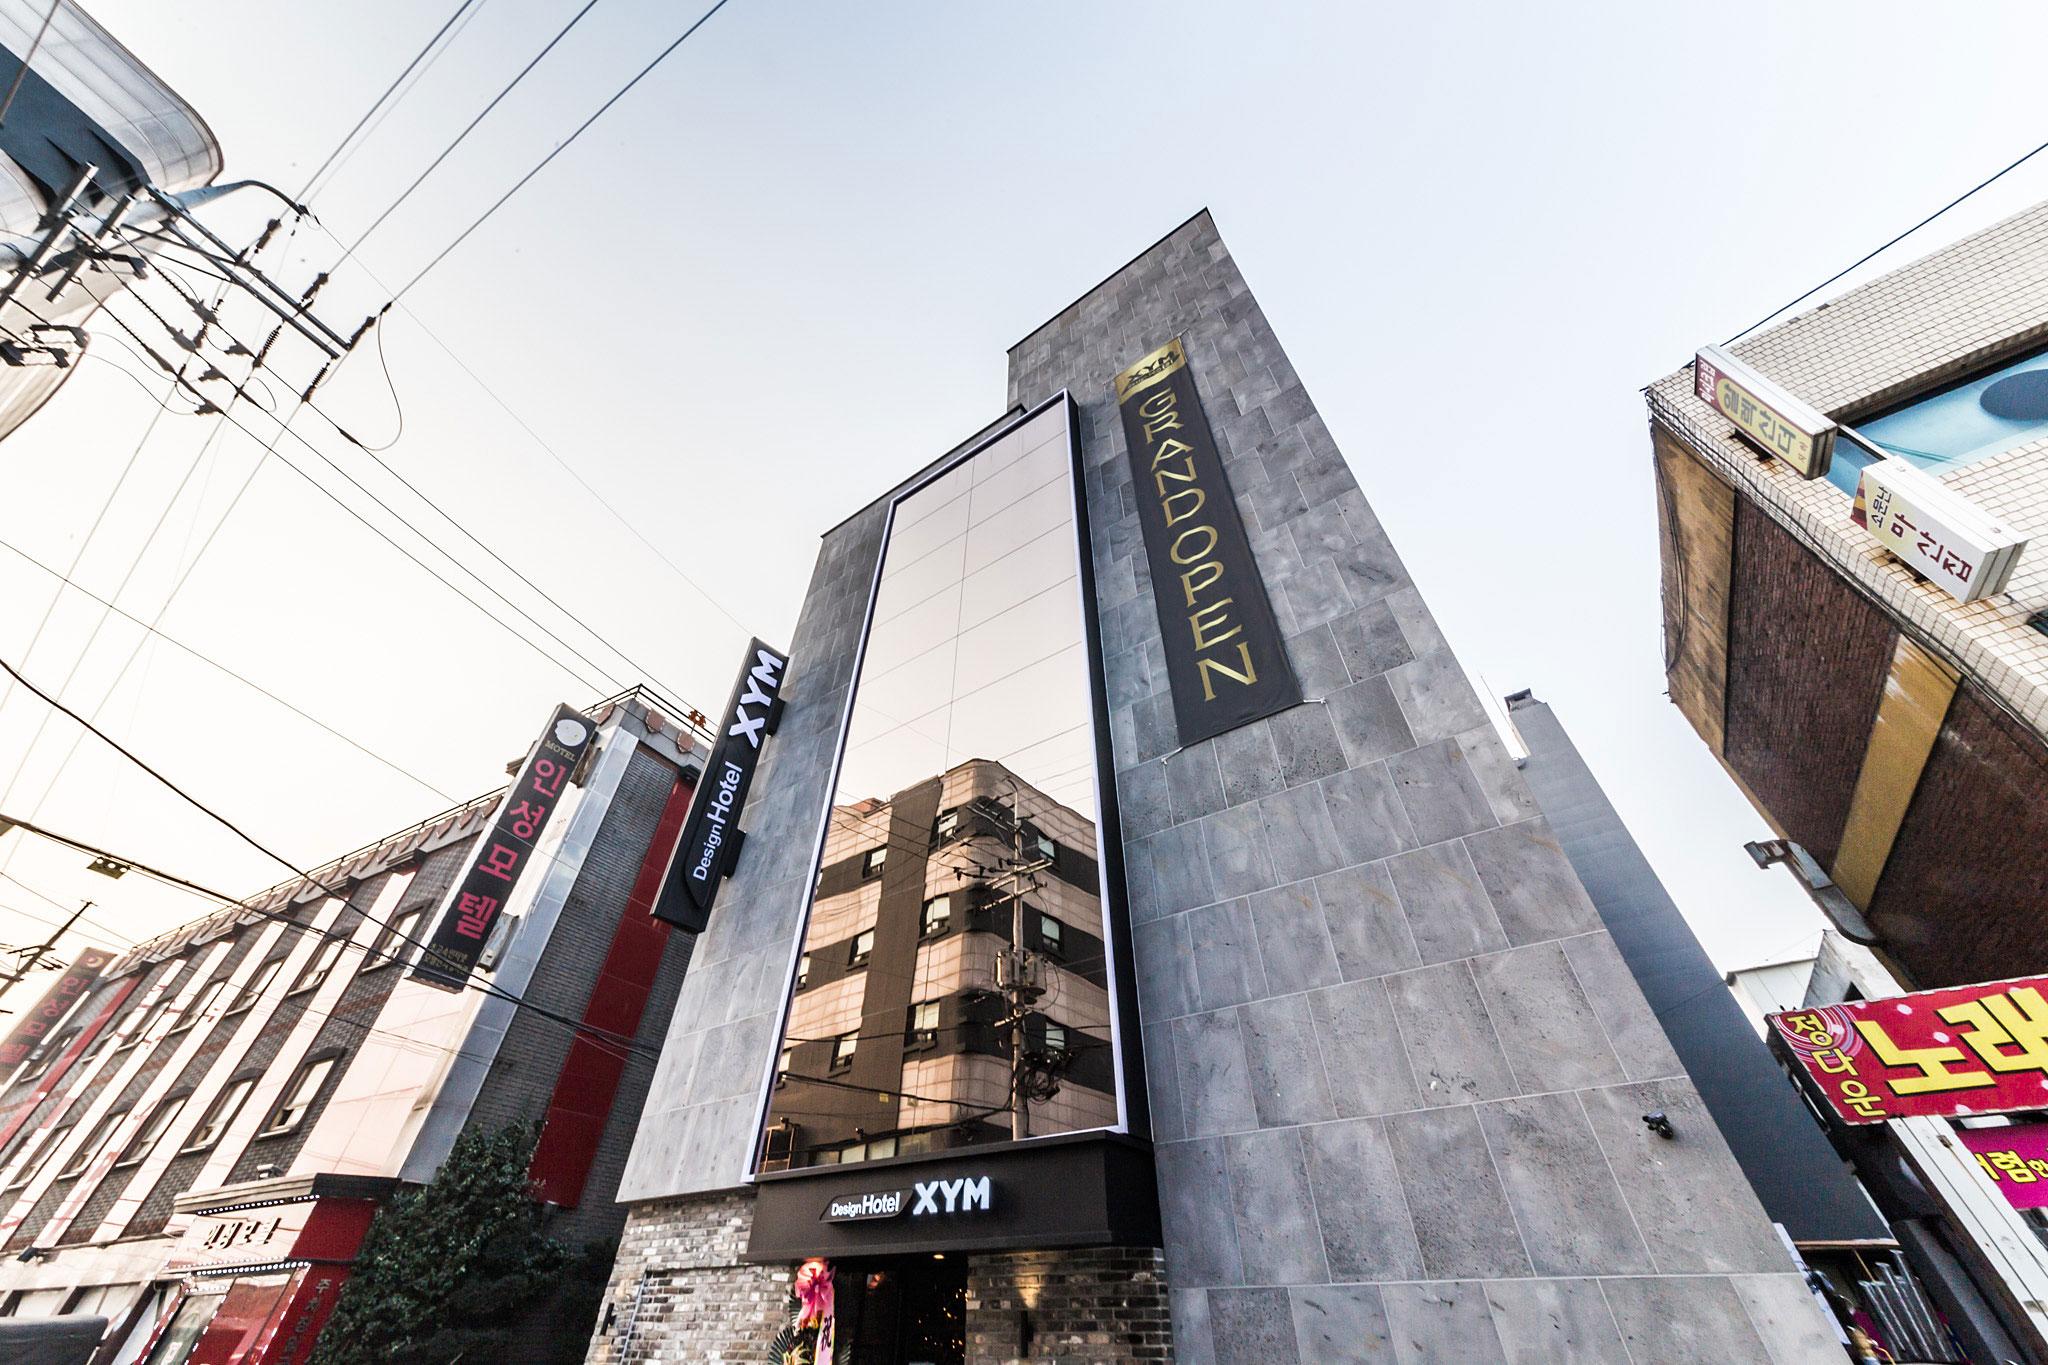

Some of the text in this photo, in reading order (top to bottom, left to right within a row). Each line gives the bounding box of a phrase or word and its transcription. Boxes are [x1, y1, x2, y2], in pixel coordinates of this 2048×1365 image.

[1721, 383, 1797, 456] 알렉산더
[1871, 485, 1893, 529] 소문난
[1891, 512, 1973, 583] 마산집
[728, 648, 783, 750] XYM
[544, 739, 577, 763] MOTEL
[455, 757, 568, 941] 인성모텔
[1786, 1013, 1887, 1117] 정다운
[912, 1175, 992, 1216] XYM
